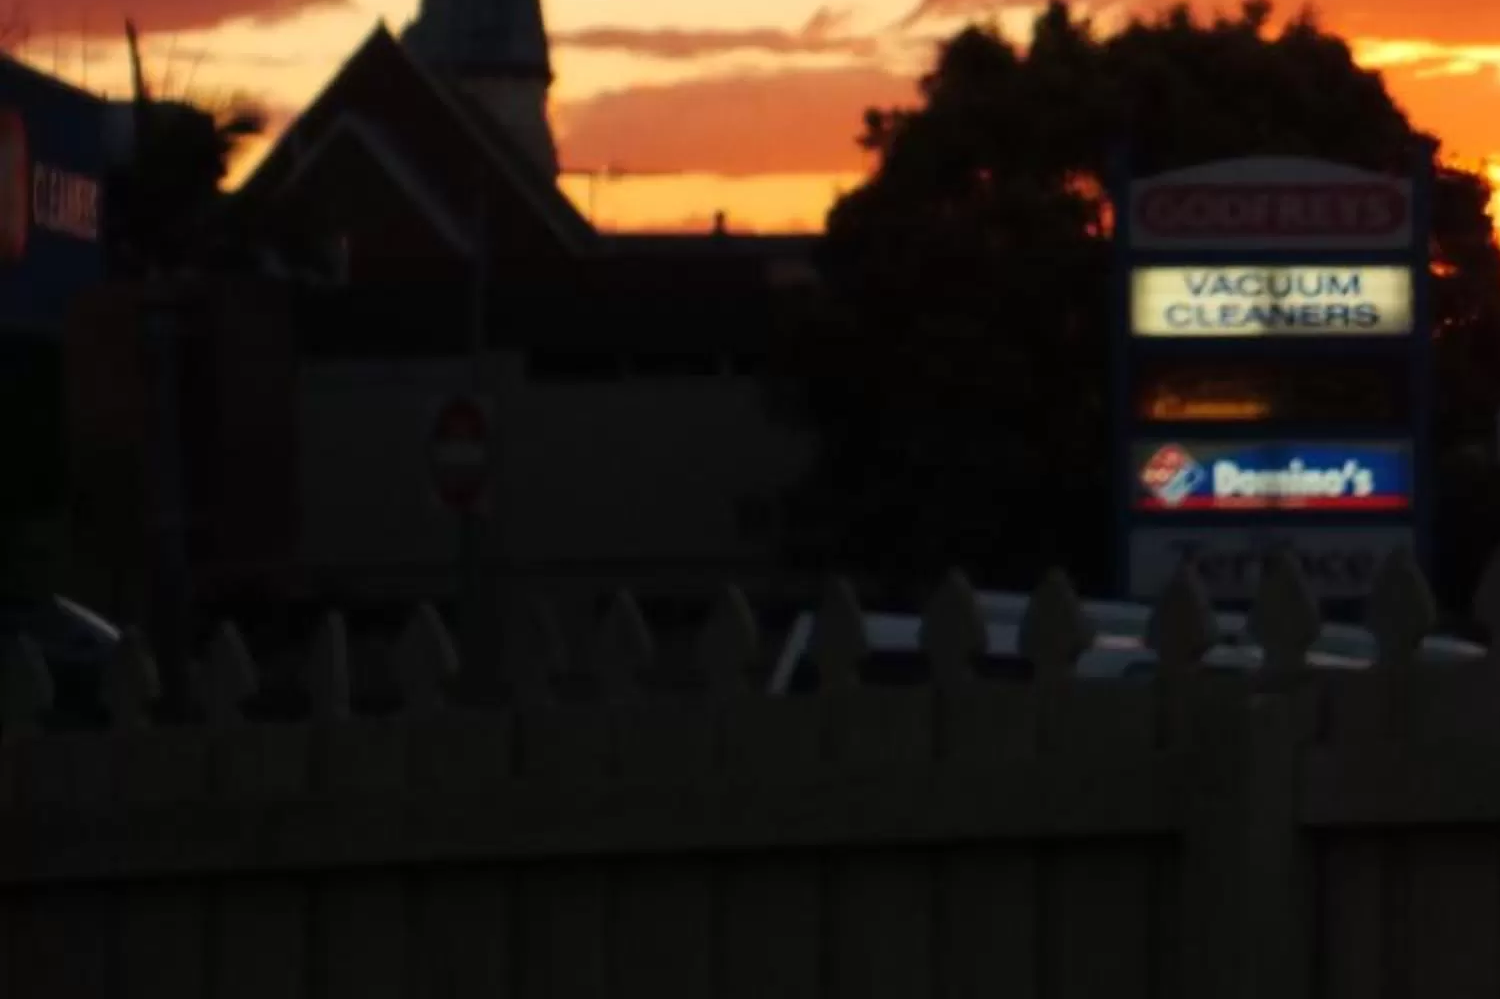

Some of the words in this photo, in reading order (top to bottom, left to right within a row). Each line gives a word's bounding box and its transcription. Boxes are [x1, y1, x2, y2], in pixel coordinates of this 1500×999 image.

[1145, 190, 1393, 231] GODFREYS
[1183, 269, 1362, 299] VACUUM
[1163, 301, 1381, 329] CLEANERS
[1212, 457, 1374, 498] Domino's
[1167, 538, 1376, 583] Terce
